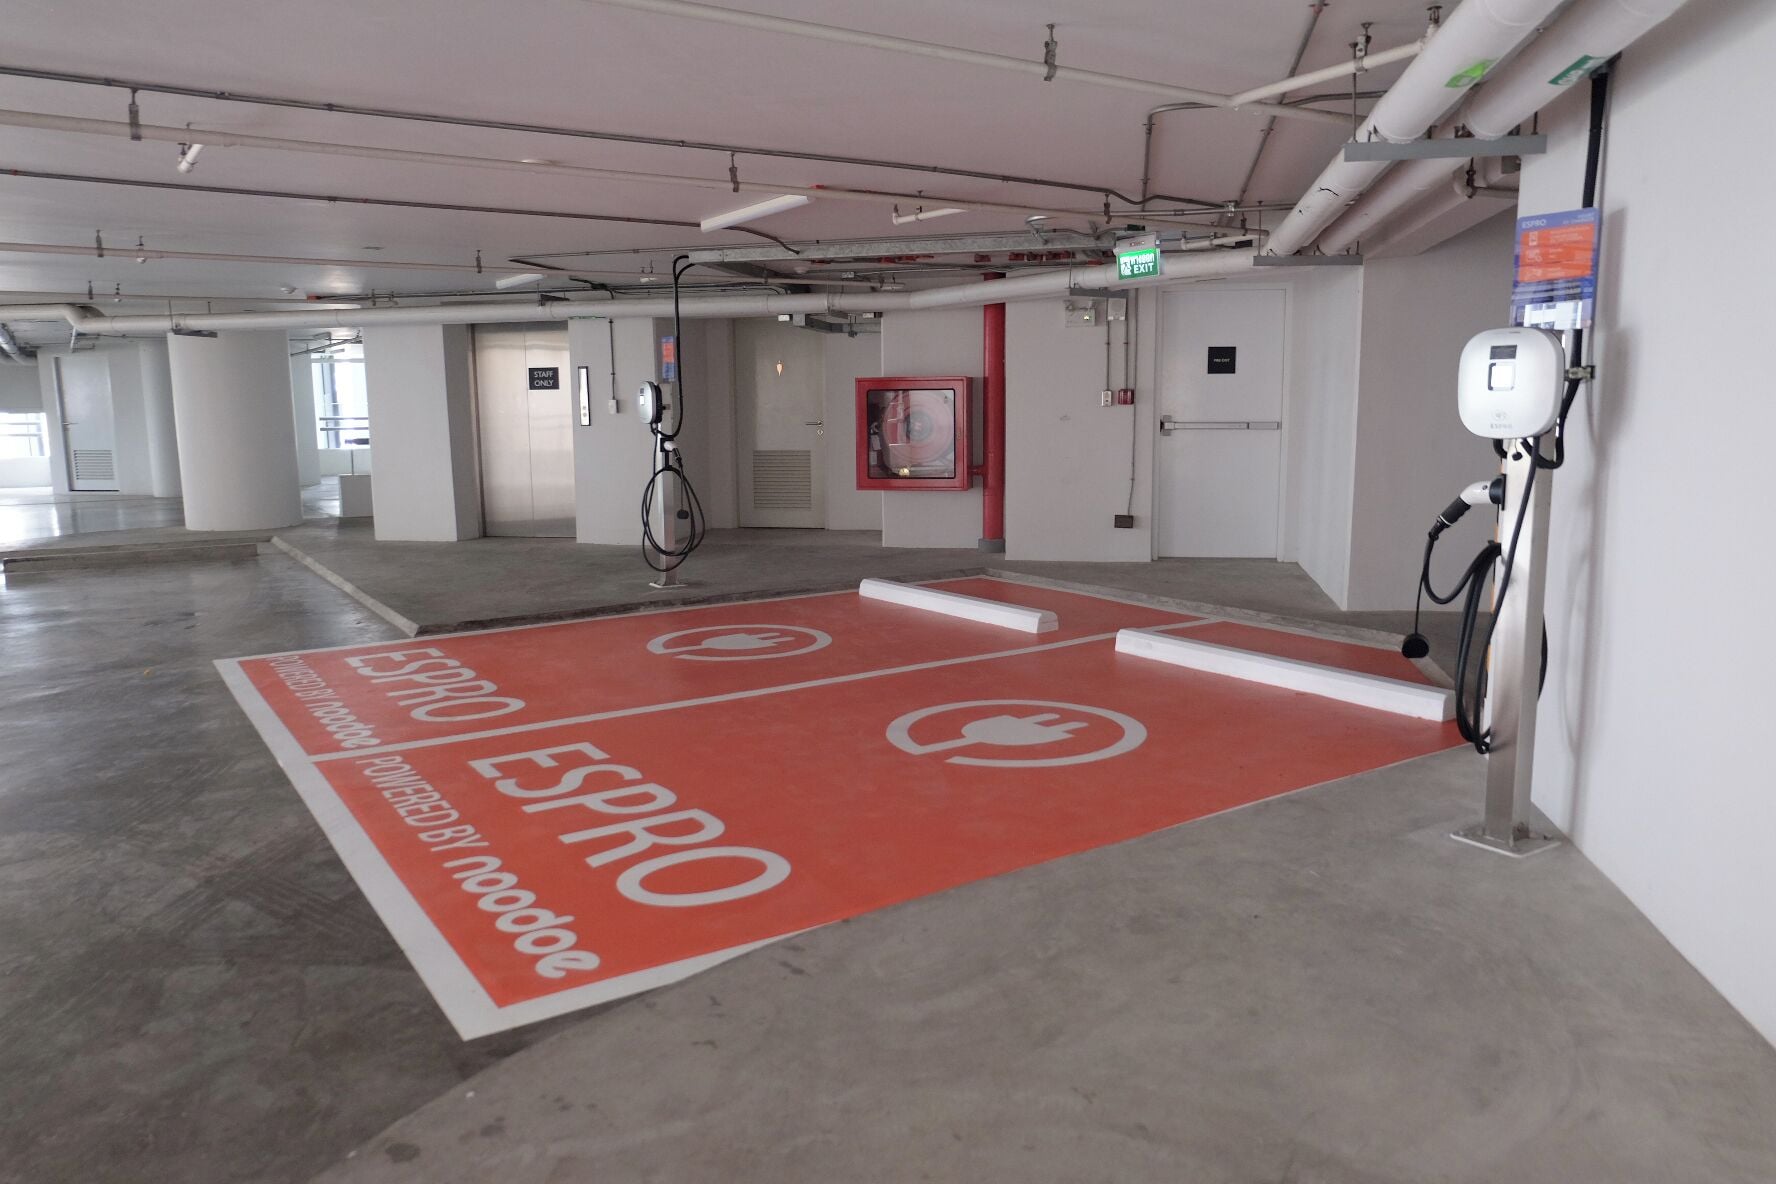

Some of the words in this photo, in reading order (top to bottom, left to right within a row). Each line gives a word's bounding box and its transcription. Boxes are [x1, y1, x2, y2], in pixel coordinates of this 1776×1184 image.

[1521, 218, 1546, 229] ESPRO
[1133, 262, 1154, 274] EXIT
[533, 370, 554, 378] STAFF
[534, 379, 554, 387] ONLY
[265, 655, 327, 690] POWERED
[344, 648, 526, 722] ESPRO
[294, 688, 340, 701] BY
[304, 701, 381, 748] noodoe
[356, 755, 460, 827] POWERED
[417, 824, 490, 852] BY
[467, 742, 791, 907] ESPRO
[442, 855, 601, 979] noodoe
